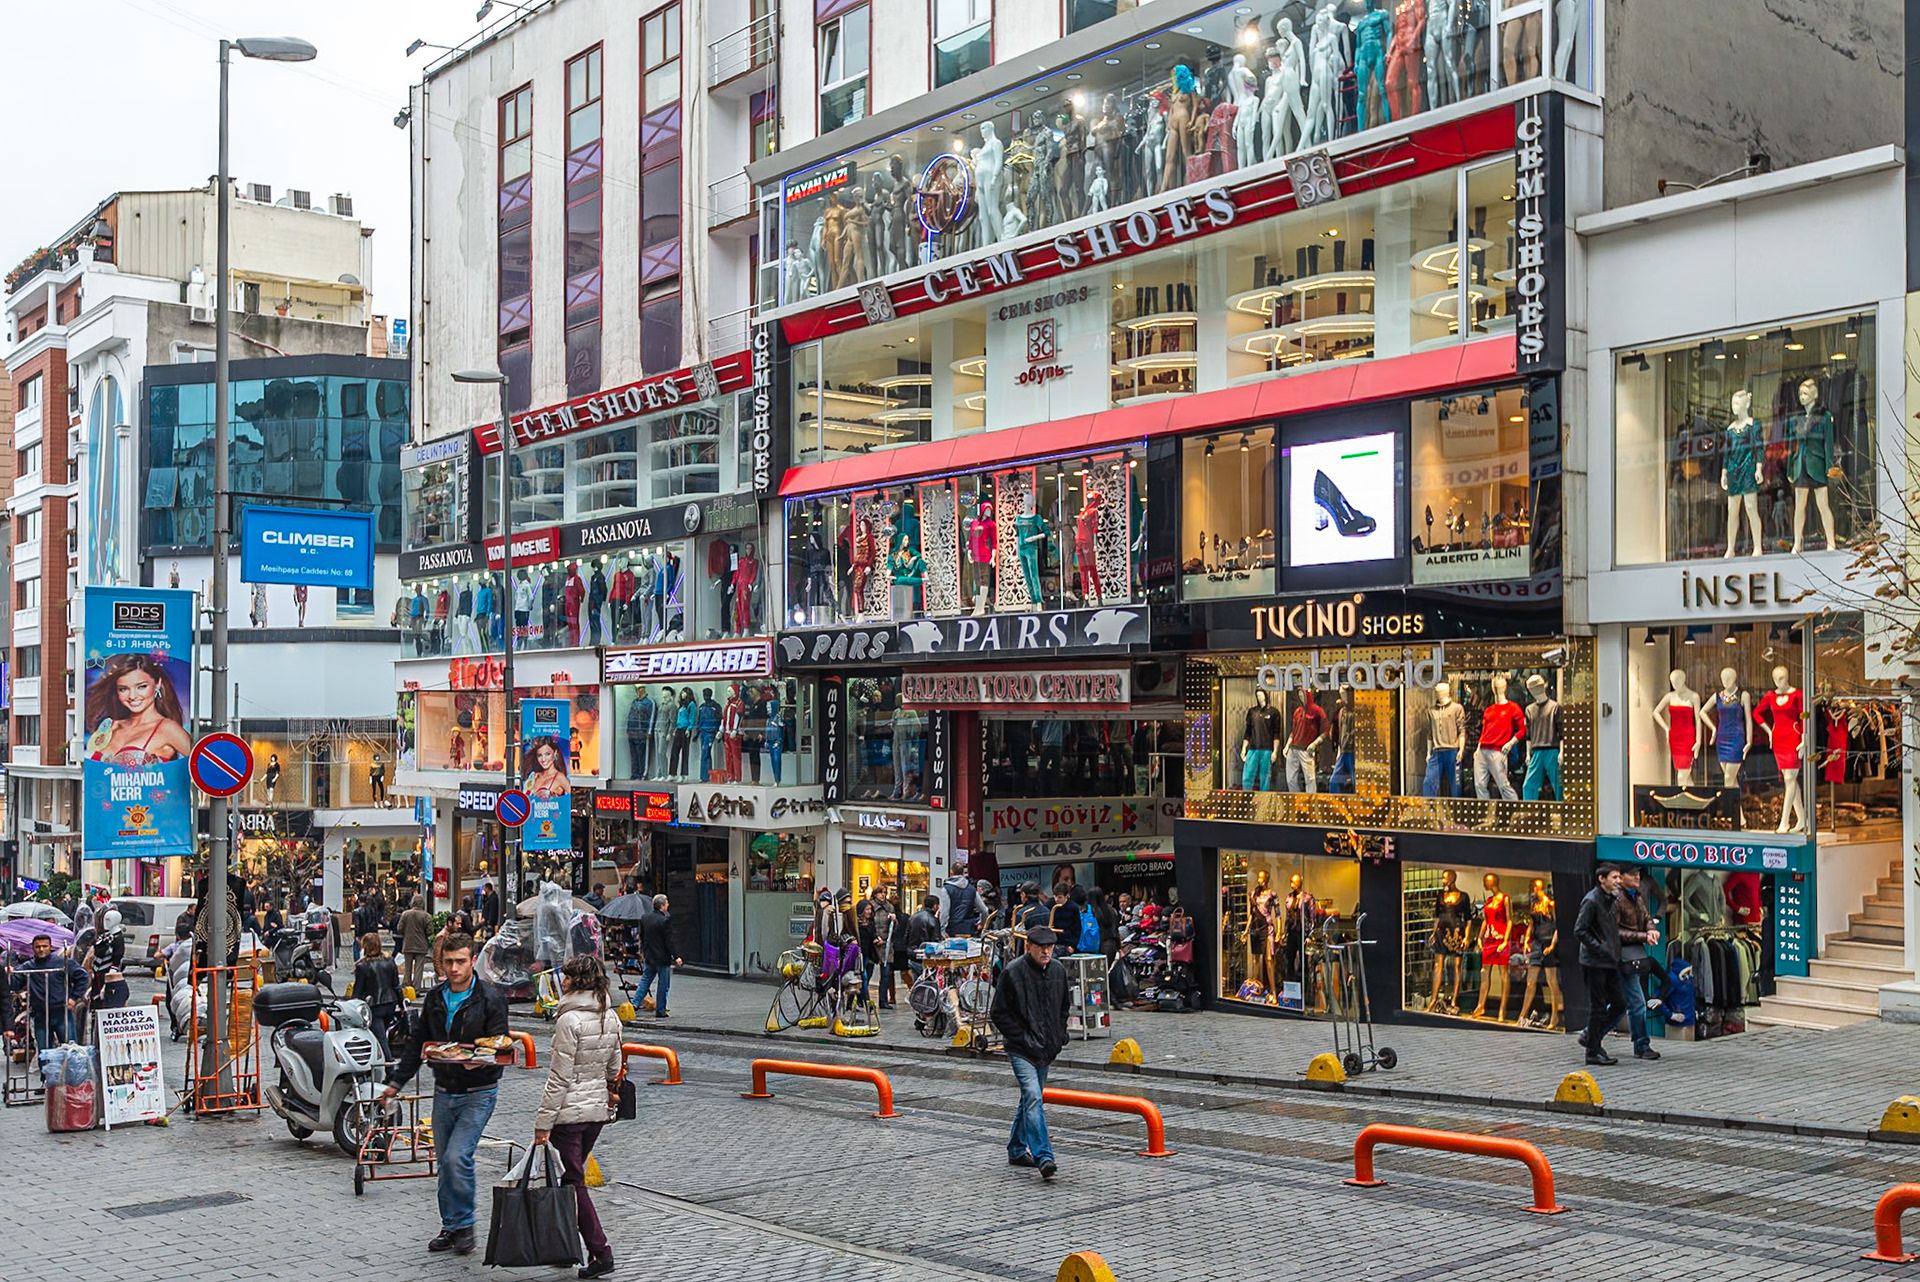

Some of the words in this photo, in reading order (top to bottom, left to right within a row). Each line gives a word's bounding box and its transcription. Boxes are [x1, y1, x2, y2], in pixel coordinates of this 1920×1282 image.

[1516, 116, 1546, 201] CEM
[786, 176, 823, 203] KAYAN
[923, 248, 1024, 303] CEM
[1053, 186, 1238, 270] SHOES
[1517, 213, 1546, 356] SHOES
[998, 300, 1032, 322] CEM
[1034, 285, 1089, 313] SHOES
[753, 330, 771, 390] CEM
[1018, 363, 1066, 386] обувь
[522, 404, 579, 441] CEM
[588, 376, 682, 424] SHOES
[415, 440, 460, 463] CELINTANO
[753, 394, 771, 490] SHOES
[713, 496, 733, 510] PURE
[704, 502, 757, 532] freedom
[262, 530, 355, 549] CLIMBER
[581, 518, 652, 546] PASSANOVA
[419, 547, 474, 571] PASSANOVA
[1425, 552, 1479, 566] ALBERTO
[300, 566, 329, 575] Caddesi
[331, 568, 344, 576] No:
[344, 569, 353, 577] 69
[119, 606, 160, 618] DDFS
[957, 613, 1070, 651] PARS
[1362, 614, 1424, 636] SHOES
[105, 639, 127, 649] 8-13
[130, 640, 171, 650] ЯНВАРЬ
[810, 630, 890, 662] PARS
[646, 648, 759, 675] FORWARD
[1257, 646, 1447, 691] antracid
[550, 671, 571, 686] girls
[902, 674, 977, 701] GALERIA
[982, 674, 1033, 700] TORO
[1038, 672, 1119, 700] CENTER
[110, 771, 165, 787] MIRANDA
[110, 786, 142, 802] KERR
[595, 795, 632, 811] KERASUS
[534, 801, 560, 810] MIRANDA
[534, 809, 549, 818] KERR
[858, 813, 887, 829] KLAS
[992, 806, 1040, 830] KOÇ
[1639, 808, 1663, 828] Just
[1667, 811, 1694, 828] Rich
[1697, 811, 1733, 830] Class
[1024, 841, 1084, 858] KLAS
[1088, 839, 1163, 858] Jewellery
[1633, 840, 1699, 863] OCCO
[1703, 845, 1747, 865] BIG
[1113, 862, 1148, 874] ROBERTO
[1149, 860, 1174, 872] BRAVO
[1788, 887, 1800, 895] XL
[1788, 897, 1800, 905] XL
[1788, 908, 1800, 916] XL
[1788, 920, 1800, 928] XL
[1788, 931, 1800, 939] XL
[102, 1017, 153, 1026] MAĞAZA
[107, 1010, 143, 1019] DEKOR
[104, 1024, 154, 1034] DEKORASYON
